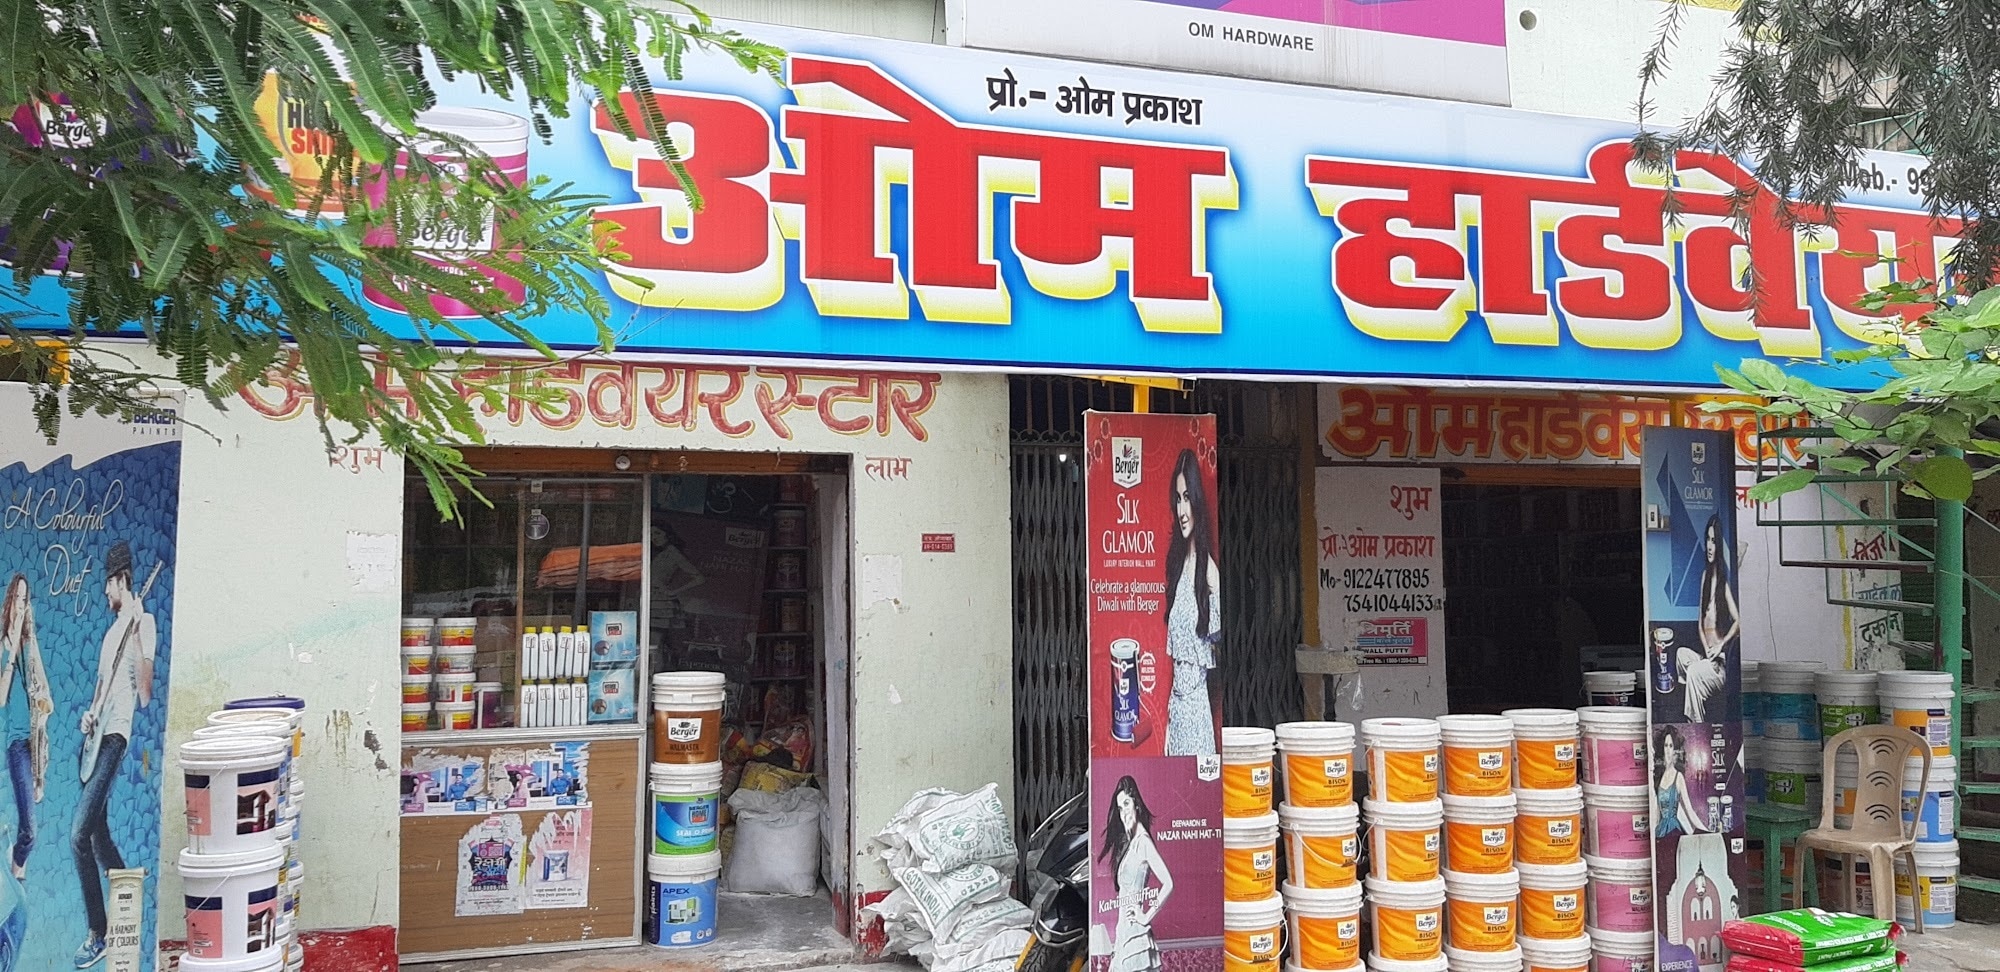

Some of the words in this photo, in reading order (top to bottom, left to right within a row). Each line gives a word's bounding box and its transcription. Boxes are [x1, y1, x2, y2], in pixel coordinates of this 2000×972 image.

[1188, 22, 1214, 39] OM
[1223, 26, 1315, 52] HARDWARE
[1055, 76, 1115, 120] ओम
[1123, 90, 1203, 127] प्रकाश
[132, 426, 176, 436] PAINTS
[1114, 456, 1140, 479] Berger
[1684, 486, 1713, 500] GLAMOR
[1390, 485, 1433, 521] शुभ
[1102, 530, 1156, 554] GLAMOR
[1382, 535, 1436, 560] प्रकाश
[43, 543, 93, 618] Duet
[1343, 568, 1430, 589] 9122477895
[1090, 578, 1124, 594] Celebrate
[1130, 578, 1166, 598] glamorous
[1097, 596, 1120, 612] Diwali
[1120, 596, 1136, 611] with
[1136, 596, 1160, 615] Berger
[1342, 594, 1434, 613] 7541044133
[669, 726, 699, 738] Berger
[1480, 758, 1501, 767] Berger
[1199, 764, 1219, 779] Berger
[1326, 766, 1346, 777] Berger
[1156, 831, 1180, 842] NAZAR
[1181, 830, 1198, 840] NAHI
[1484, 835, 1504, 843] Berger
[662, 887, 691, 895] APEX
[1486, 914, 1507, 923] Berger
[1252, 940, 1273, 951] Berger
[1661, 960, 1693, 972] EXPERIENCE
